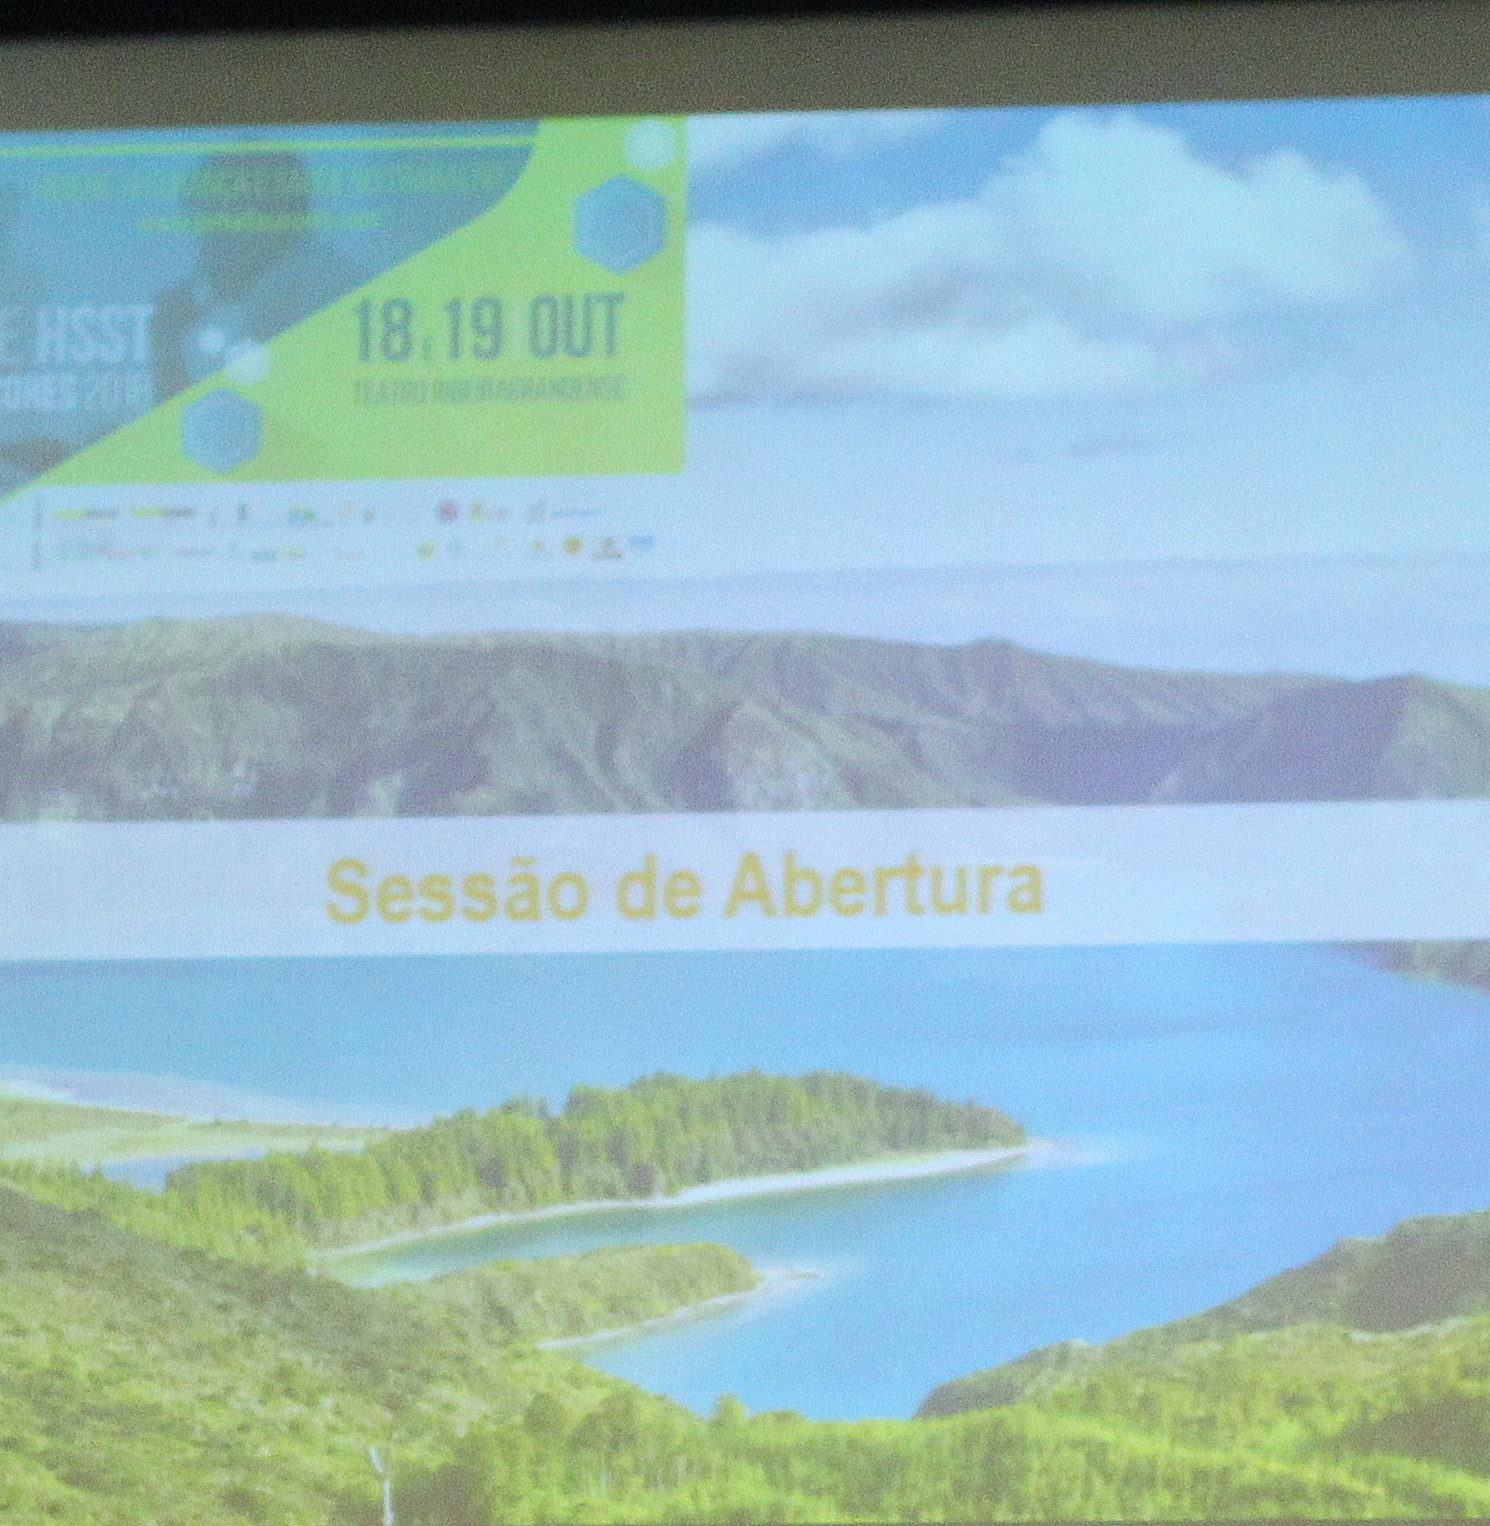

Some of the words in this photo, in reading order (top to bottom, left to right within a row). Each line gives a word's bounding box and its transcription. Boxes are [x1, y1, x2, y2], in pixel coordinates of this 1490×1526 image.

[353, 295, 414, 363] 18
[445, 294, 504, 361] 19
[528, 291, 625, 359] OUT
[324, 856, 589, 925] Sessão
[615, 854, 704, 920] de
[721, 850, 1047, 919] Abertura
